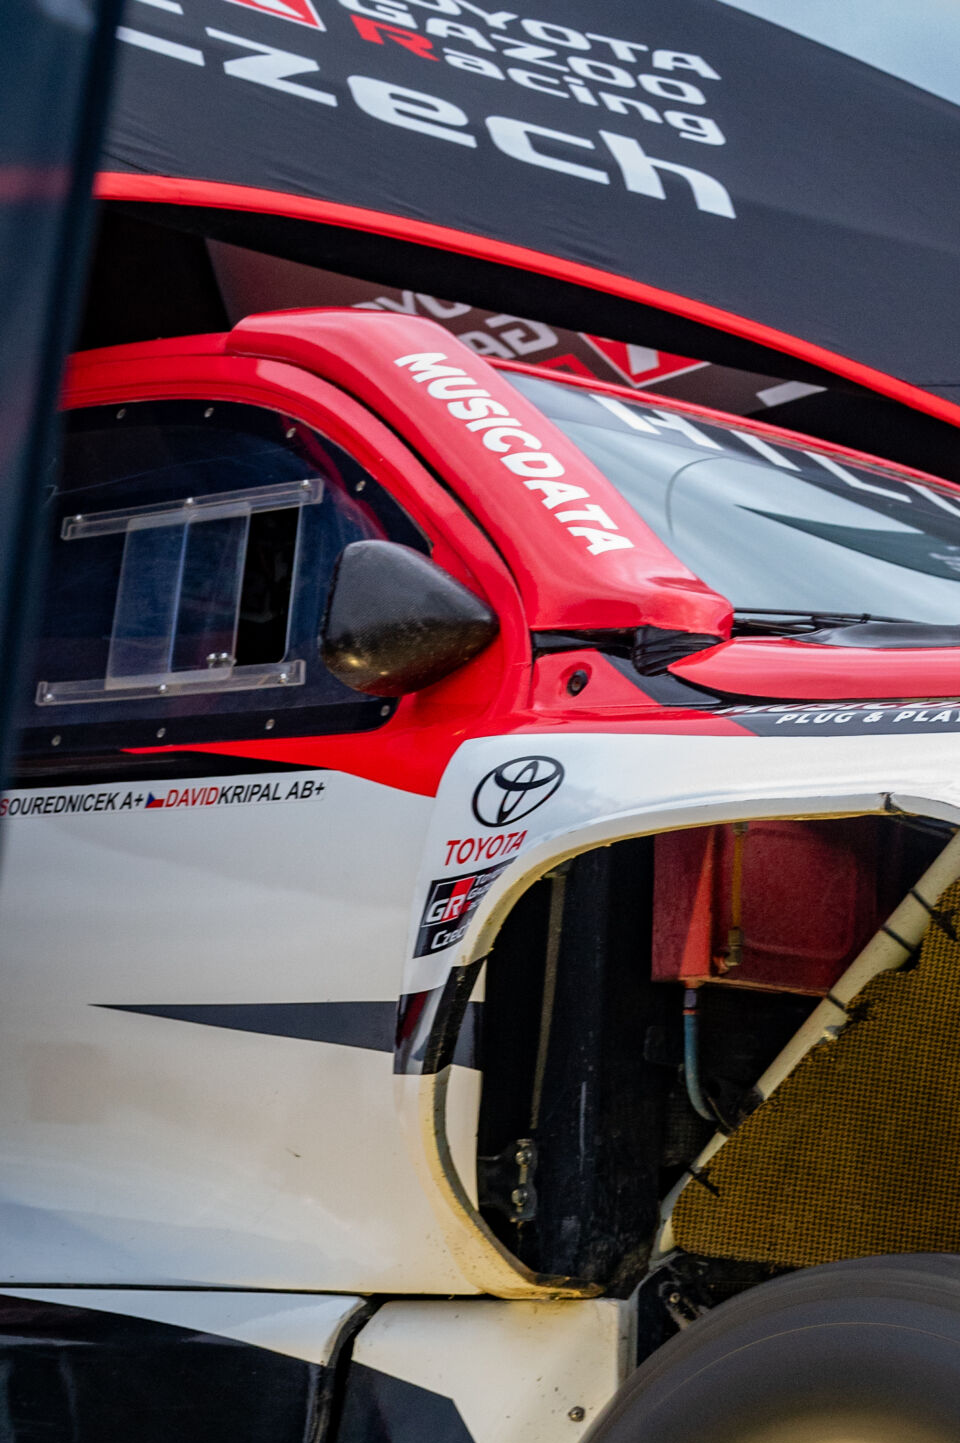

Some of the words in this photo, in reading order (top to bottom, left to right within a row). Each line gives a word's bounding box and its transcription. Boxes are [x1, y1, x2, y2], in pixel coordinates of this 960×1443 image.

[403, 0, 722, 80] YOTA
[350, 15, 727, 146] Racing
[394, 352, 635, 556] MUSICDATA
[775, 711, 857, 725] PLUG
[862, 711, 884, 724] &
[285, 780, 326, 800] AB+
[444, 829, 529, 867] TOYOTA
